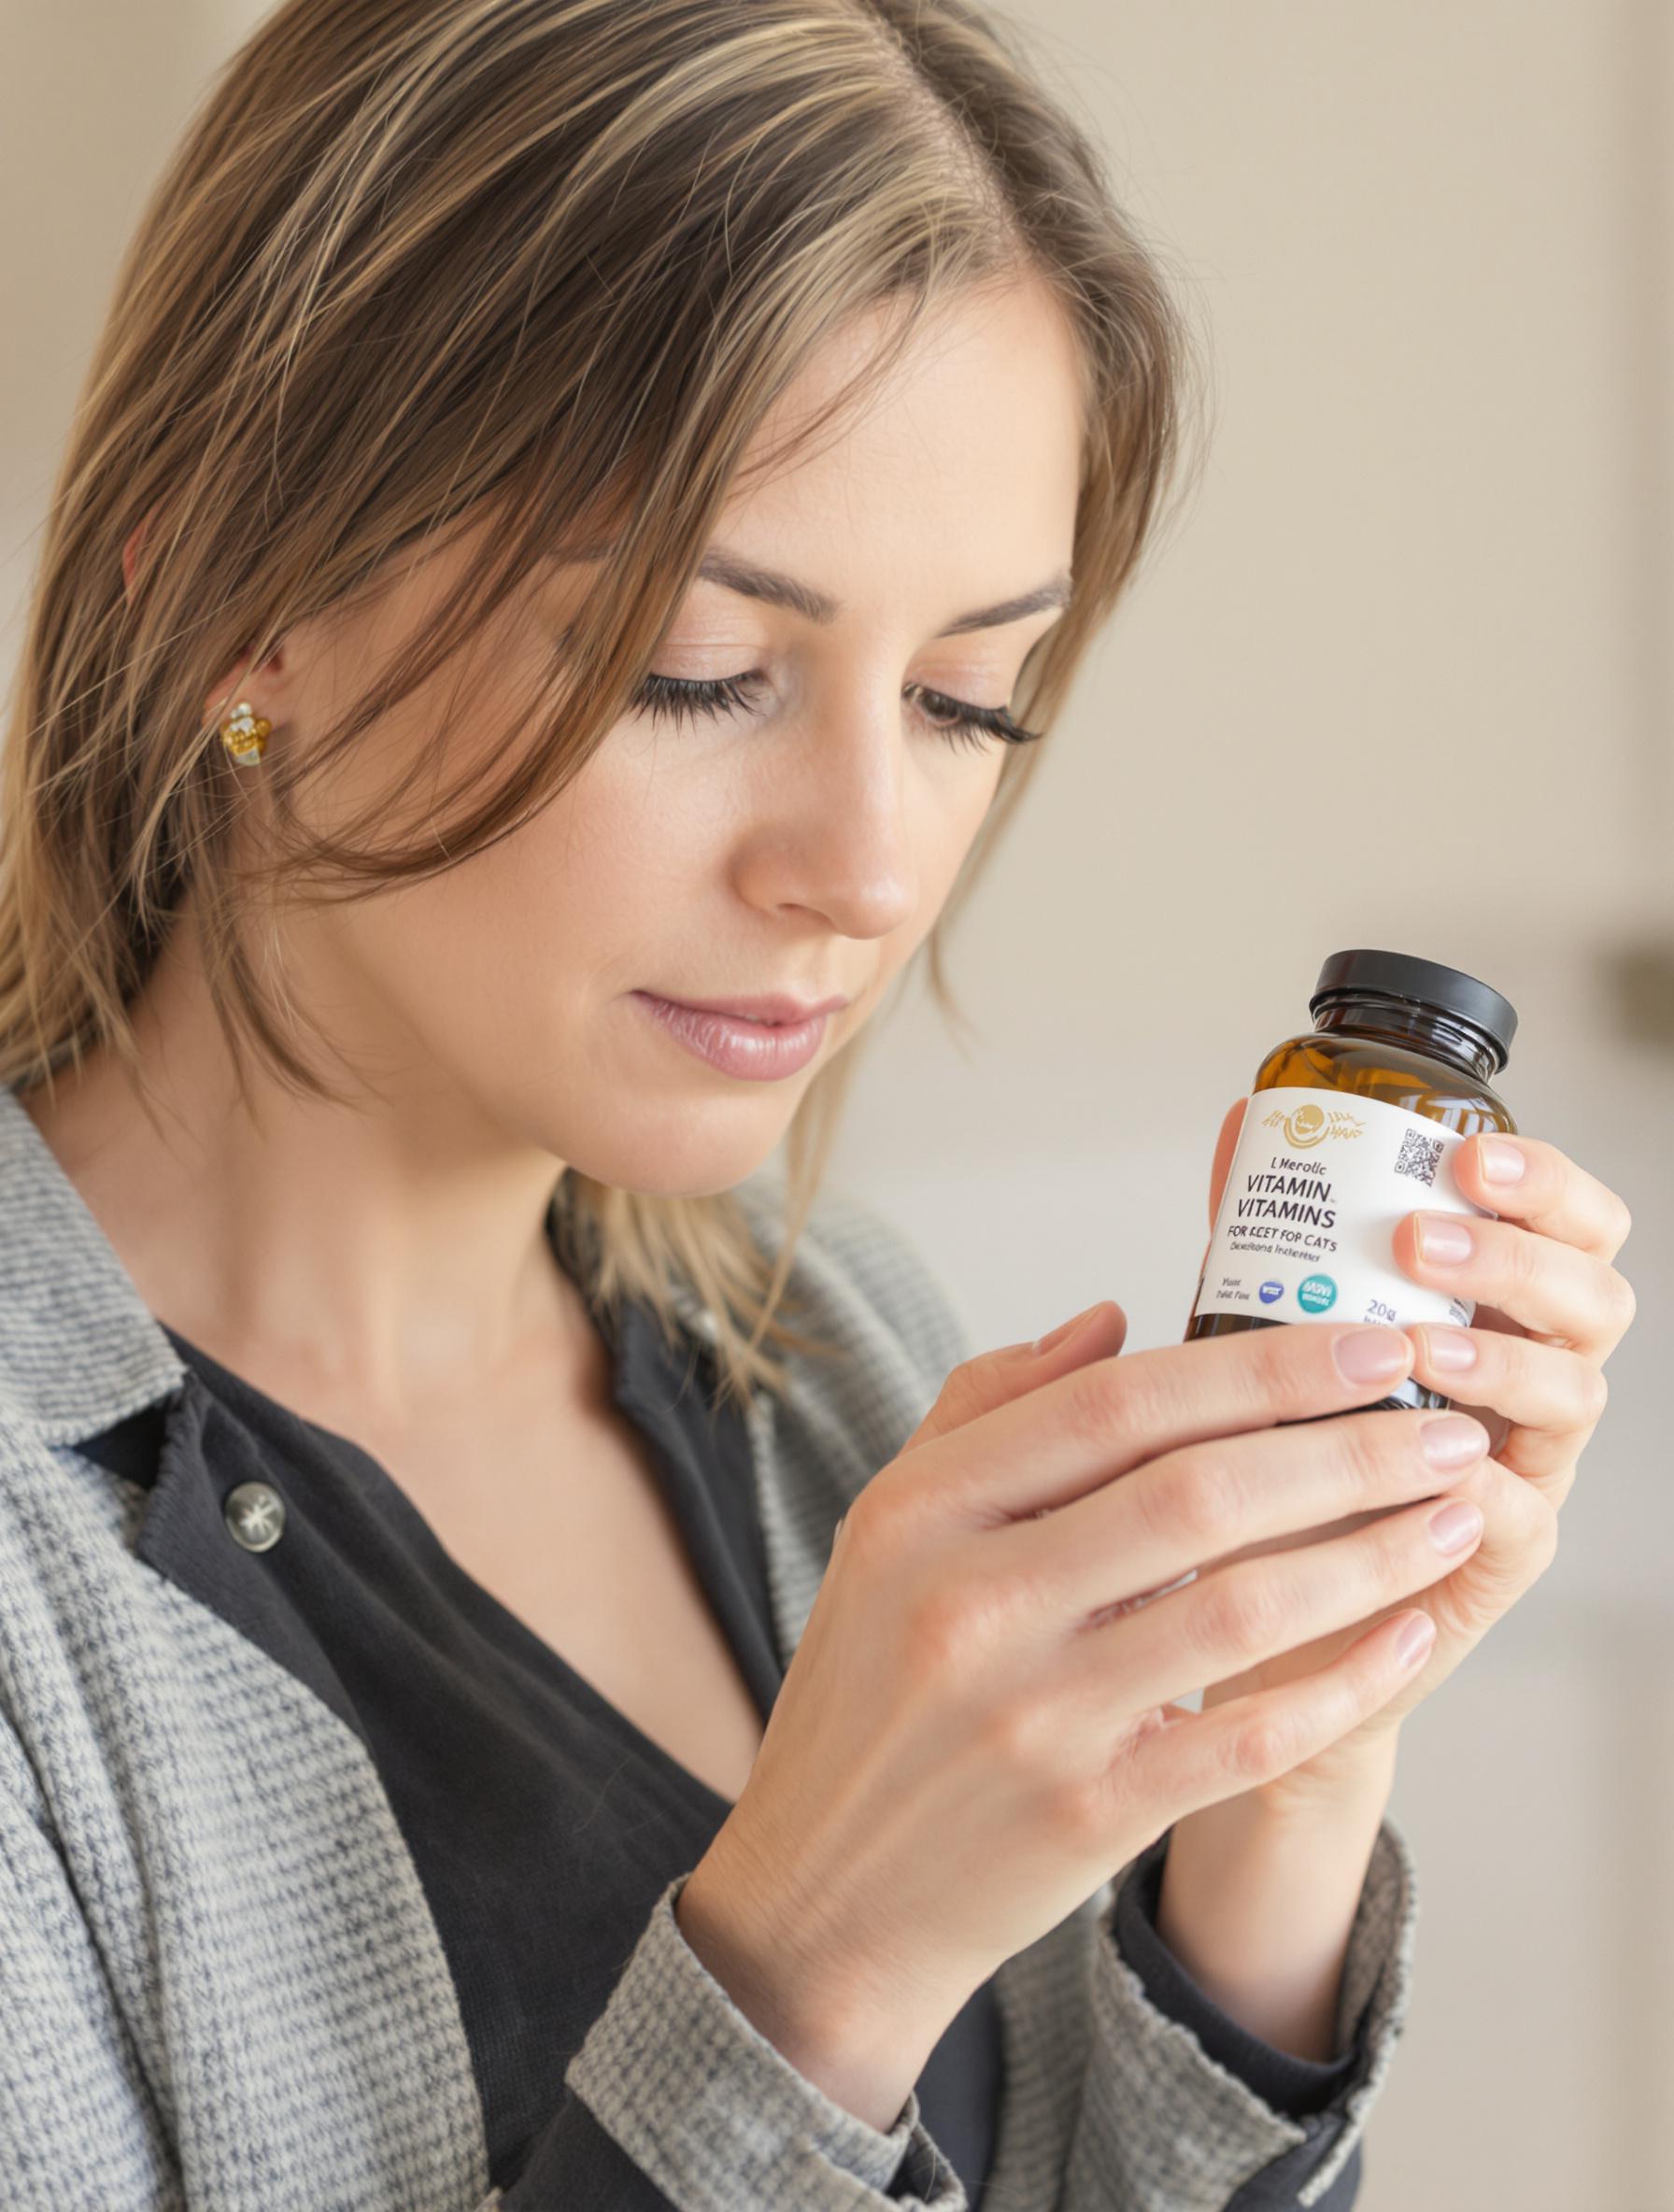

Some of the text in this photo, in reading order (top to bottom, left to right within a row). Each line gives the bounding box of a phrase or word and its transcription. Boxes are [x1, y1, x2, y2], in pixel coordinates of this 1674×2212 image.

[1247, 1174, 1331, 1202] VITAMIN
[1238, 1198, 1337, 1228] VITAMINS
[1227, 1225, 1248, 1238] FOR
[1304, 1234, 1338, 1252] CATS
